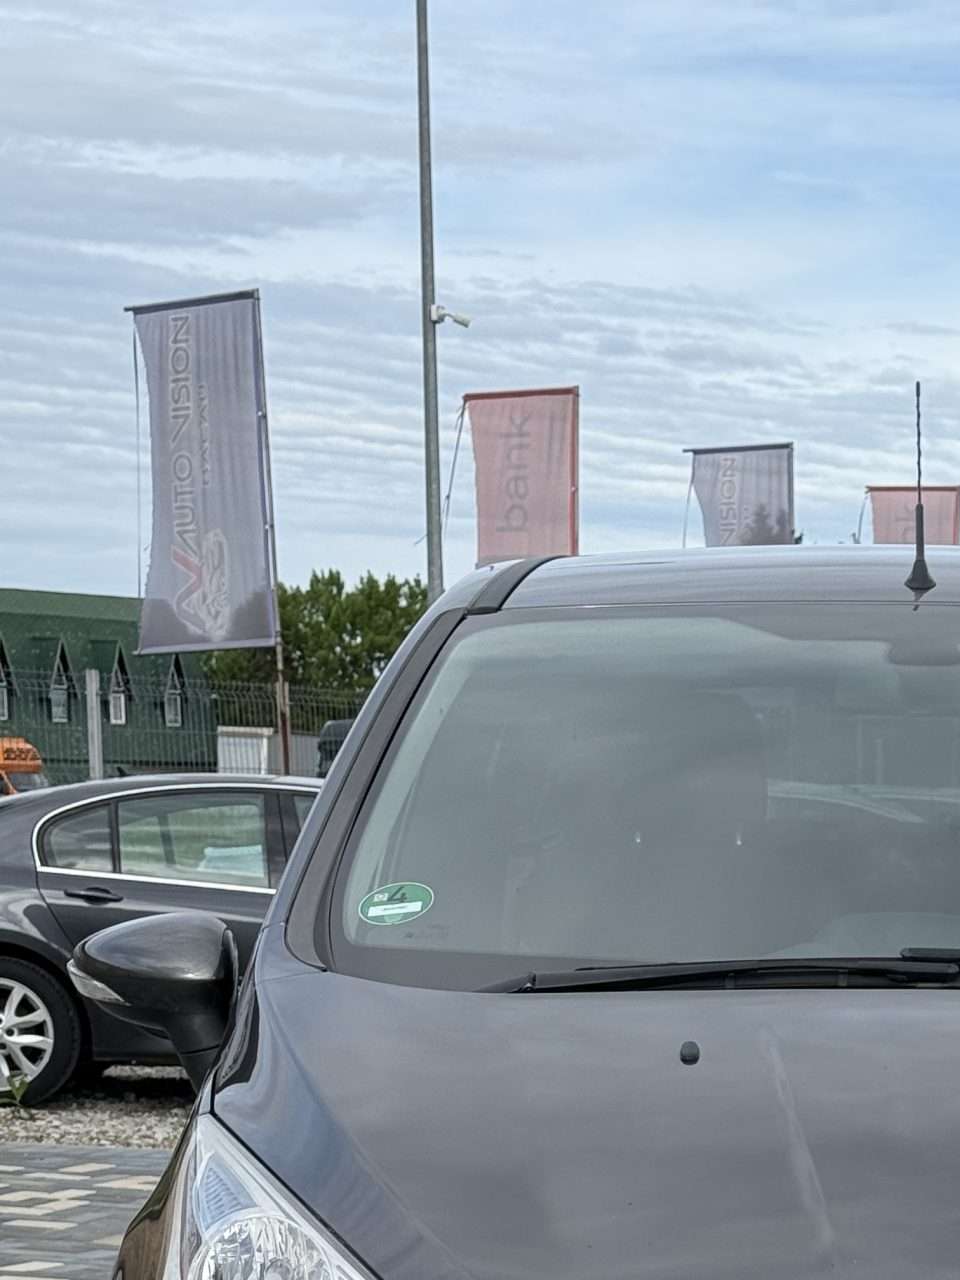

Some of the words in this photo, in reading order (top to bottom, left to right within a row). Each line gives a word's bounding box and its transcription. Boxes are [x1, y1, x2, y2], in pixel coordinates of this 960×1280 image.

[170, 315, 192, 444] VISION
[173, 453, 200, 557] AUTO
[496, 411, 531, 533] bank
[720, 457, 737, 545] VISION
